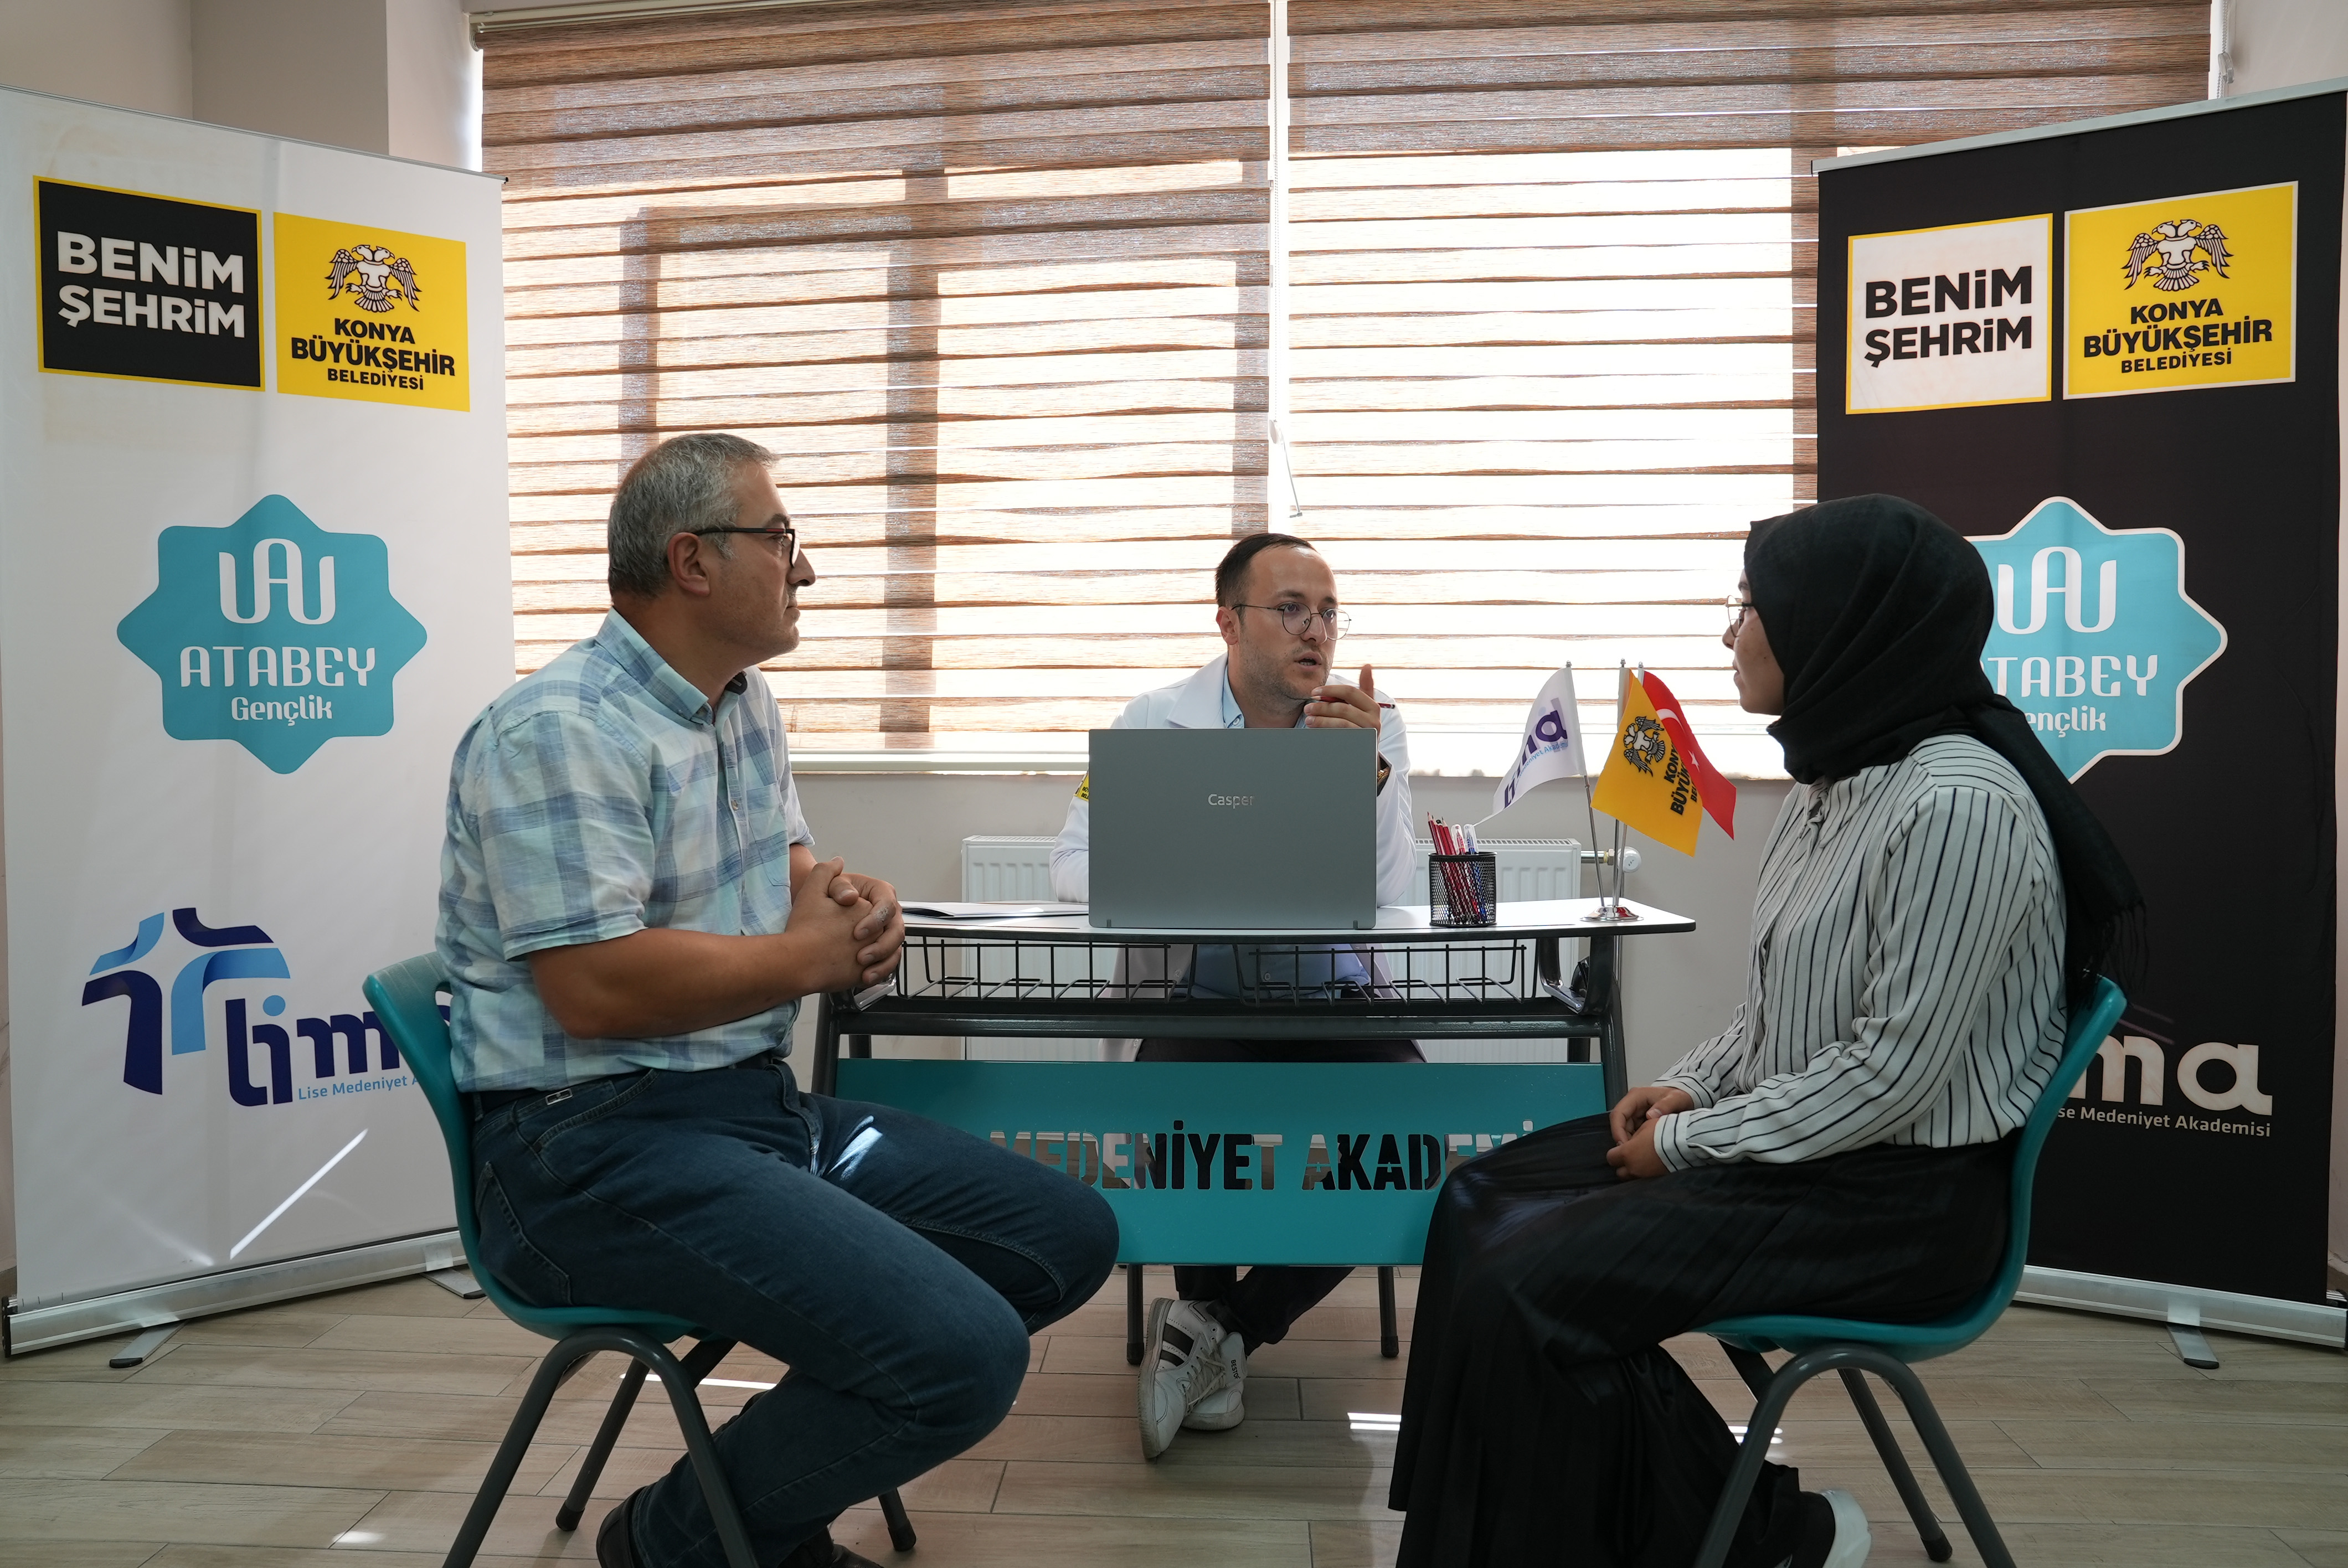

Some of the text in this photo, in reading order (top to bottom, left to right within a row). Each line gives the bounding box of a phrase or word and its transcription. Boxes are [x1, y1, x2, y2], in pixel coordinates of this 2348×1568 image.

[2130, 298, 2223, 324] KONYA
[334, 317, 415, 344] KONYA
[2083, 316, 2273, 358] BÜYÜKŞEHİR
[291, 335, 455, 376] BÜYÜKŞEHİR
[2121, 351, 2232, 373] BELEDİYESİ
[327, 368, 424, 390] BELEDİYESİ
[180, 646, 375, 687] ATABEY
[1980, 654, 2158, 697] TABEY
[231, 694, 332, 726] Gençlik
[1664, 742, 1678, 783] KONY
[1208, 794, 1254, 809] Casper
[225, 995, 450, 1107] lim
[298, 1086, 328, 1100] Lise
[333, 1076, 408, 1096] Medeniyet
[2068, 1035, 2273, 1116] ma
[2057, 1106, 2270, 1137] se Medeniyet Akademisi
